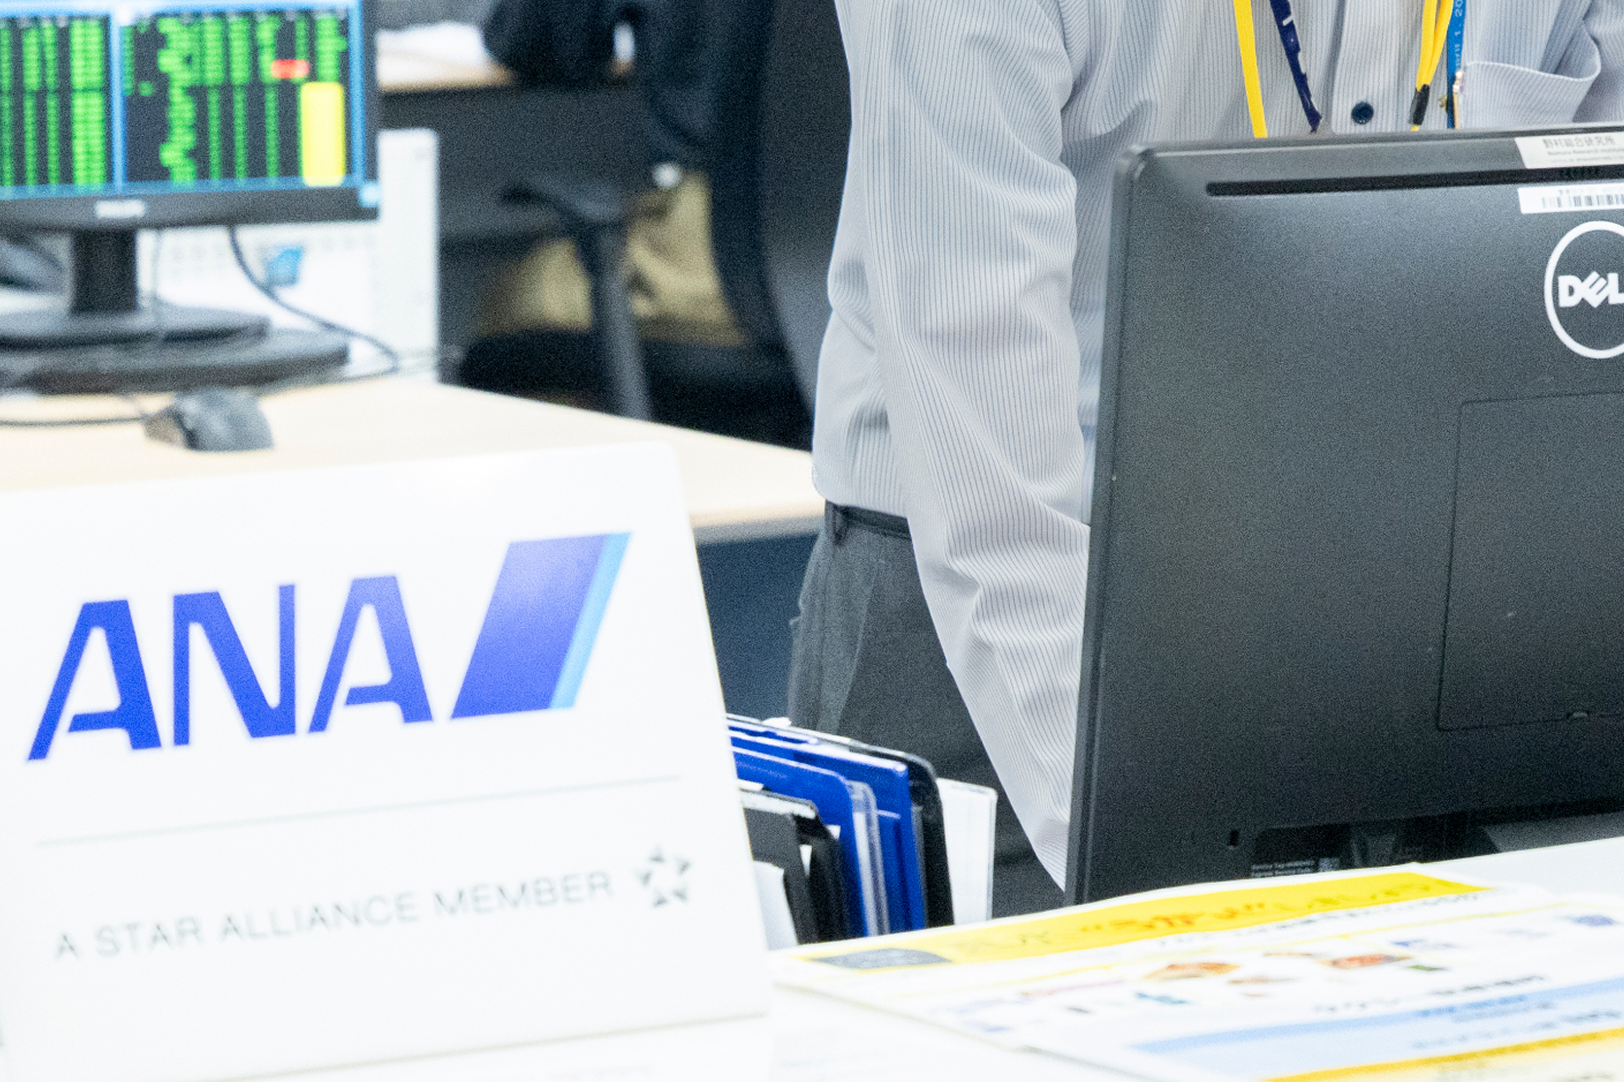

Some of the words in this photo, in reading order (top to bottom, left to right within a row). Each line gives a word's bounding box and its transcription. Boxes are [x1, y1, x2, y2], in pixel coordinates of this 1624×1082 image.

[26, 574, 434, 762] ANA
[55, 931, 82, 961] A
[95, 915, 205, 958] STAR
[220, 891, 418, 943] ALLIANCE
[435, 870, 613, 918] MEMBER
